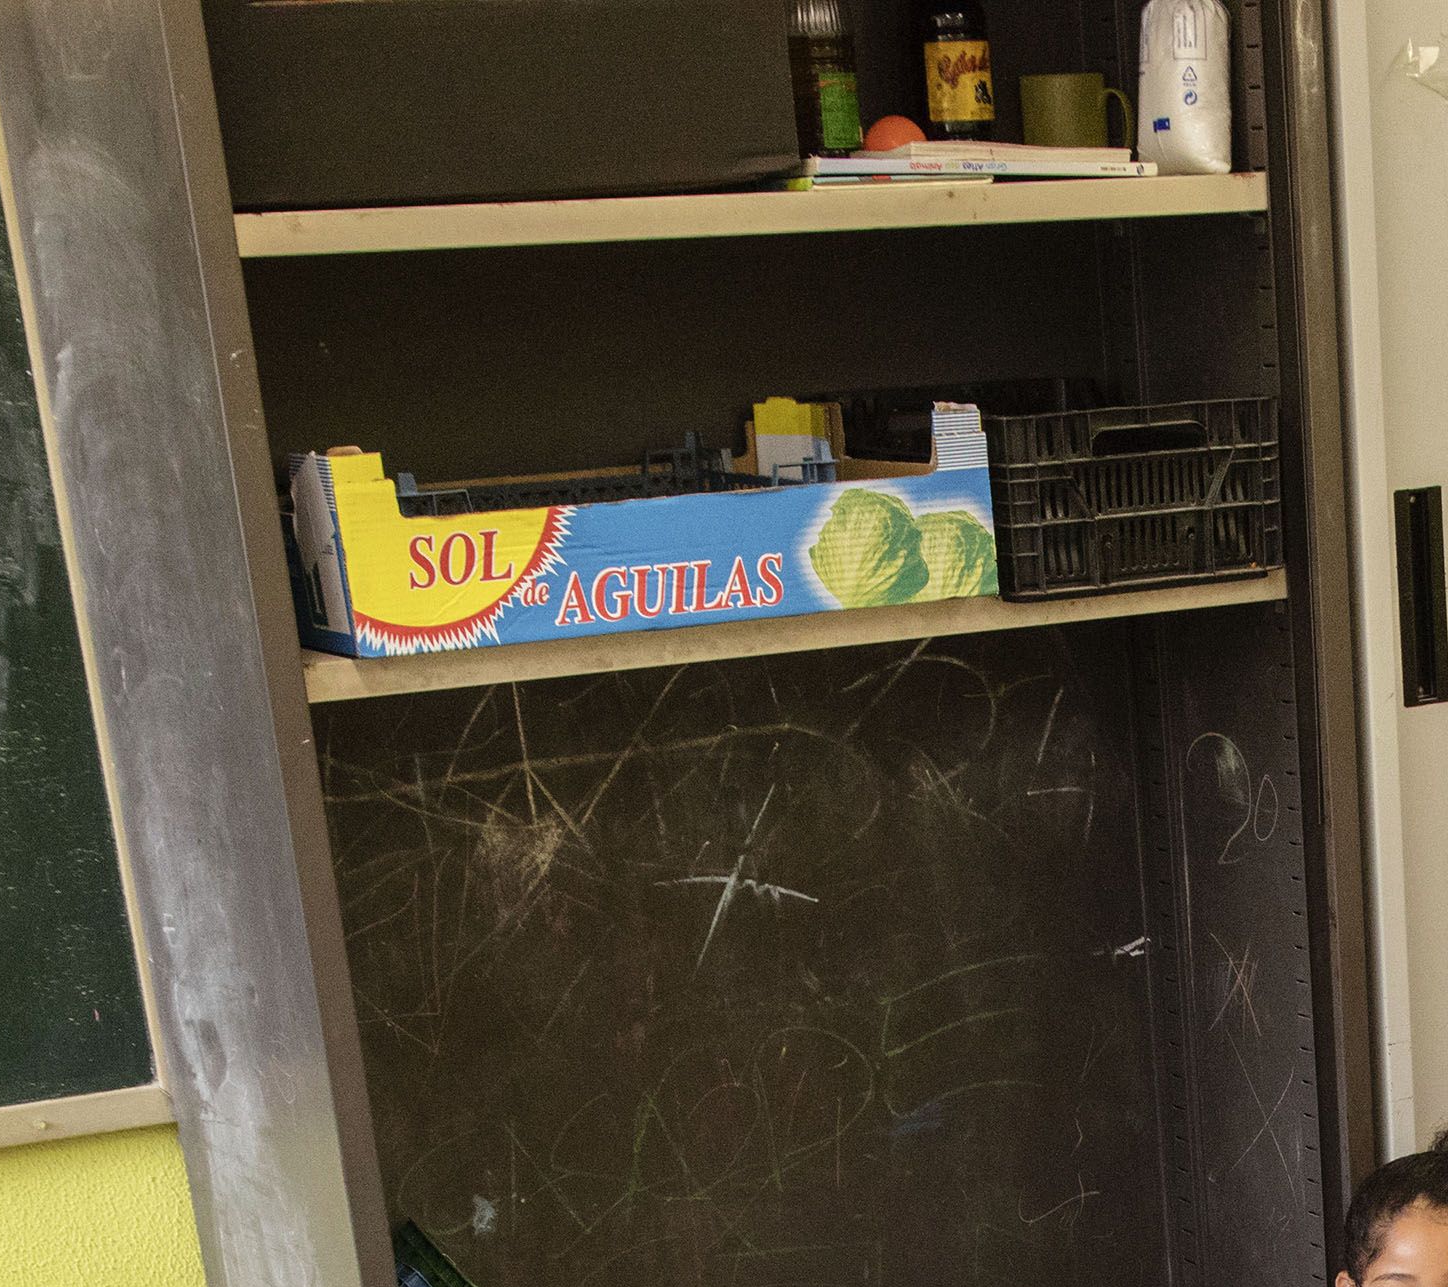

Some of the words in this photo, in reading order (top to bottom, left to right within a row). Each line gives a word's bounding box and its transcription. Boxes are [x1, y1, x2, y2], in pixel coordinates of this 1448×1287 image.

[408, 529, 514, 590] SOL
[520, 581, 550, 606] de
[555, 552, 784, 627] AGUILAS
